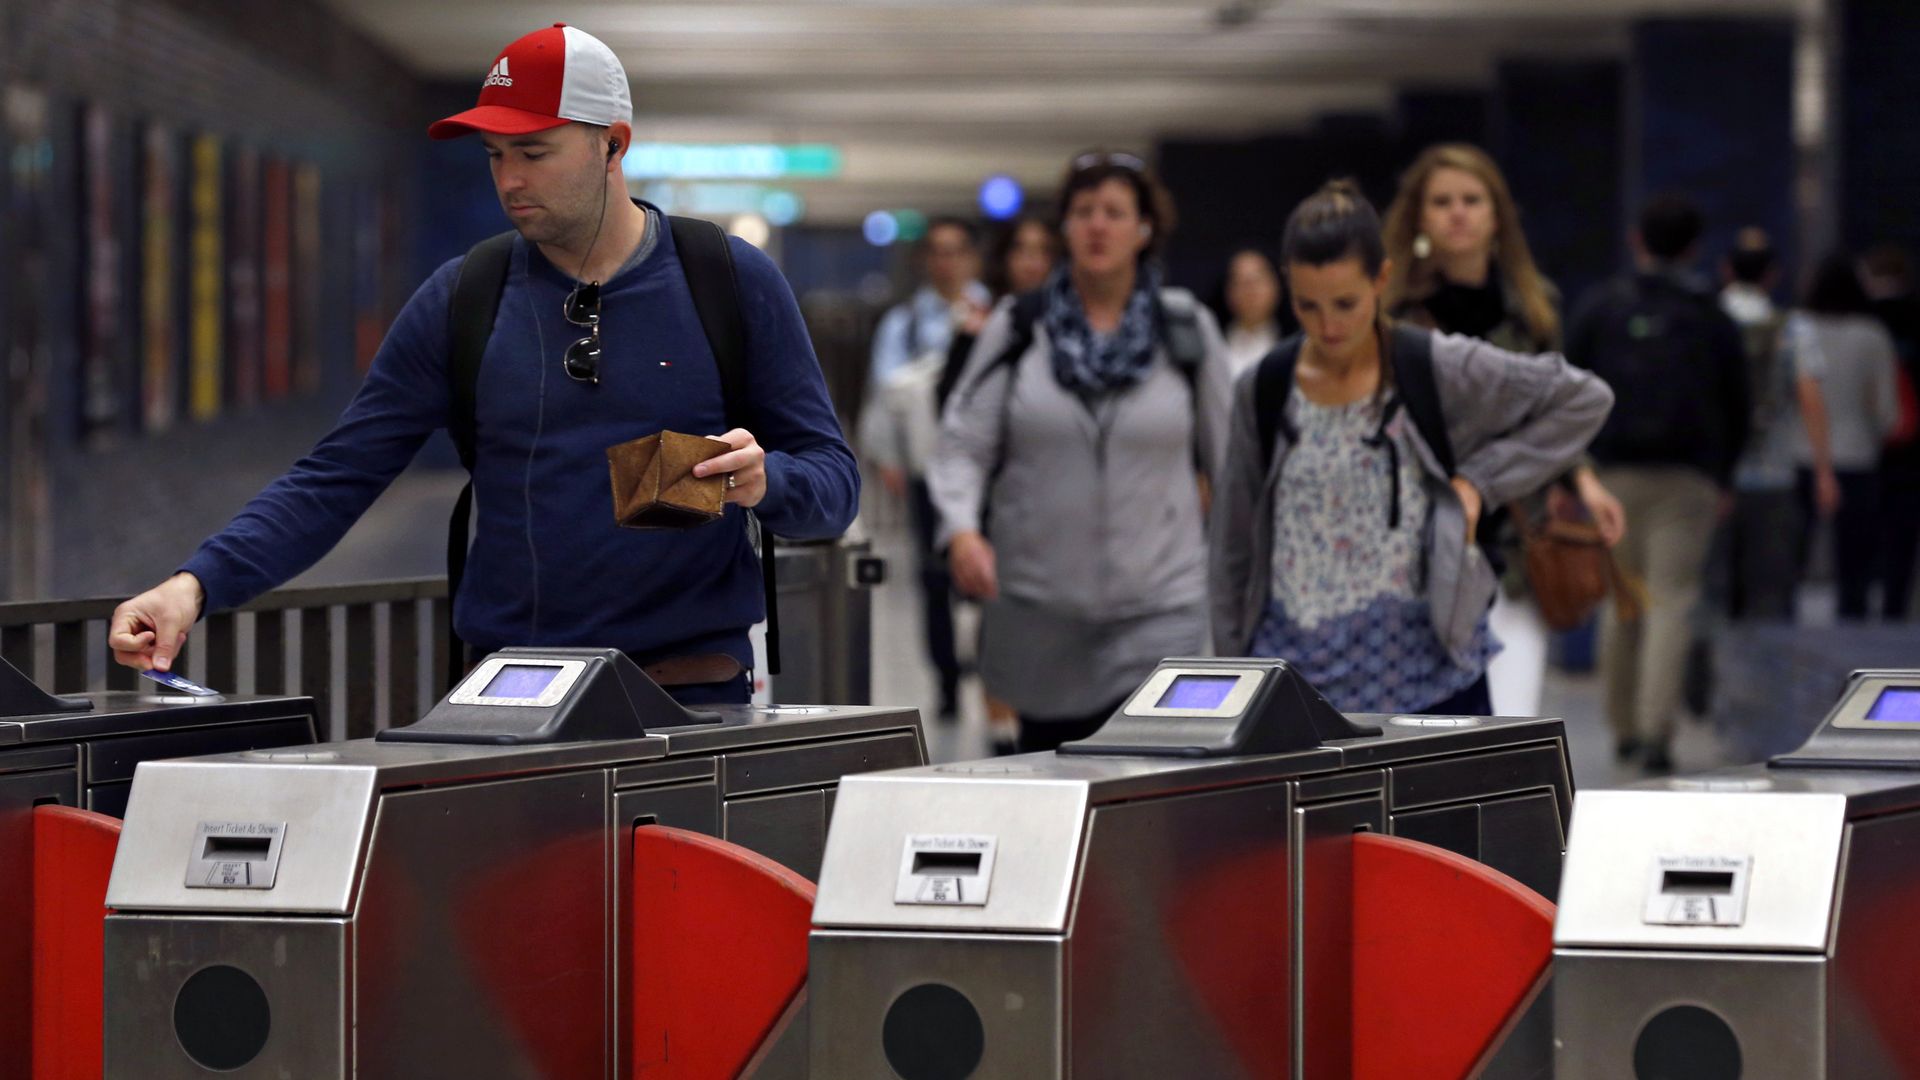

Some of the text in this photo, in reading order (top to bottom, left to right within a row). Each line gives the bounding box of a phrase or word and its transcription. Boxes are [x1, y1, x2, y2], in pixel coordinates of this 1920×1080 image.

[482, 74, 513, 88] didas
[203, 823, 224, 833] Insert
[226, 823, 246, 834] Ticket
